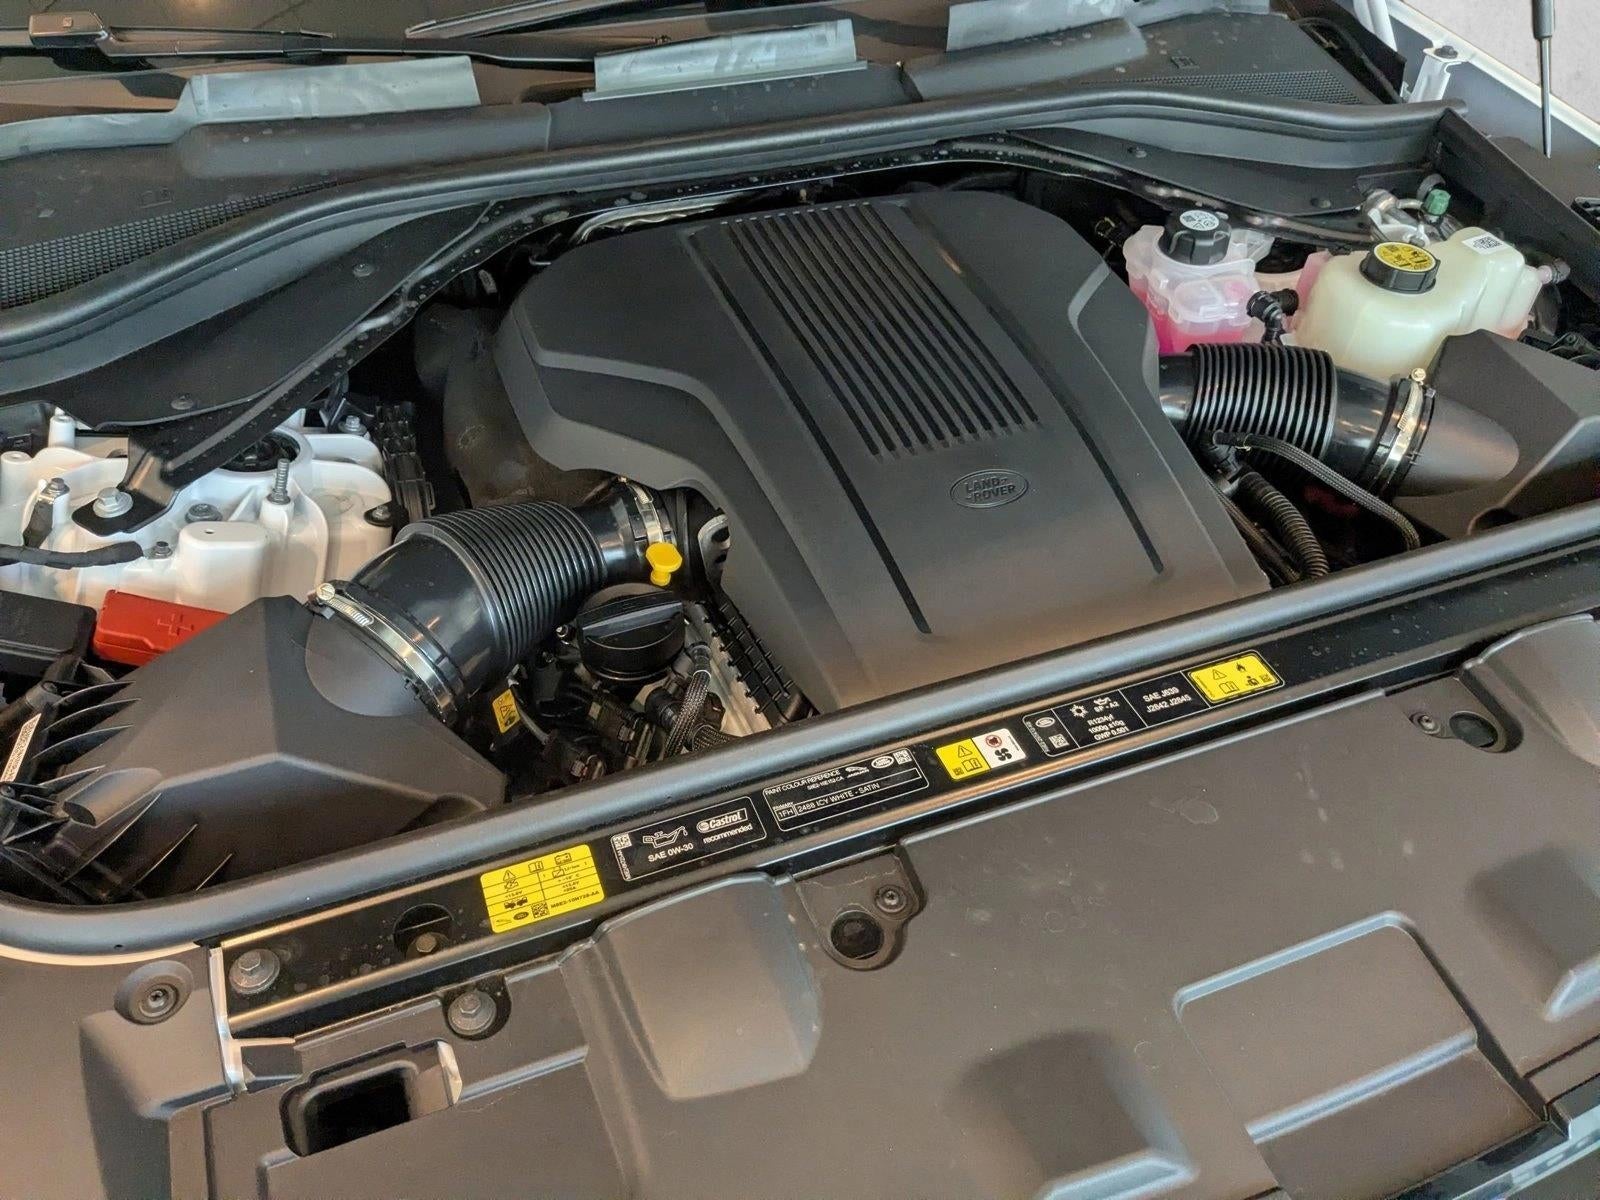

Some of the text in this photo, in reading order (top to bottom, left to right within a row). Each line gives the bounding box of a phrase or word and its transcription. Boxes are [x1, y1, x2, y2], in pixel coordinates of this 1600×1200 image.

[964, 476, 1001, 493] LAND
[973, 483, 1017, 502] ROVER
[1142, 686, 1180, 702] SAE J639
[1146, 694, 1192, 713] J2842 J2845
[765, 770, 841, 796] PAINT COLOUR REFERENCE
[817, 798, 829, 808] ICY
[830, 790, 853, 804] WHITE
[859, 782, 881, 797] SATIN
[709, 811, 743, 829] Castrol
[778, 808, 794, 818] 1FH
[703, 823, 754, 844] recommended
[648, 843, 694, 863] SAE 0W-30
